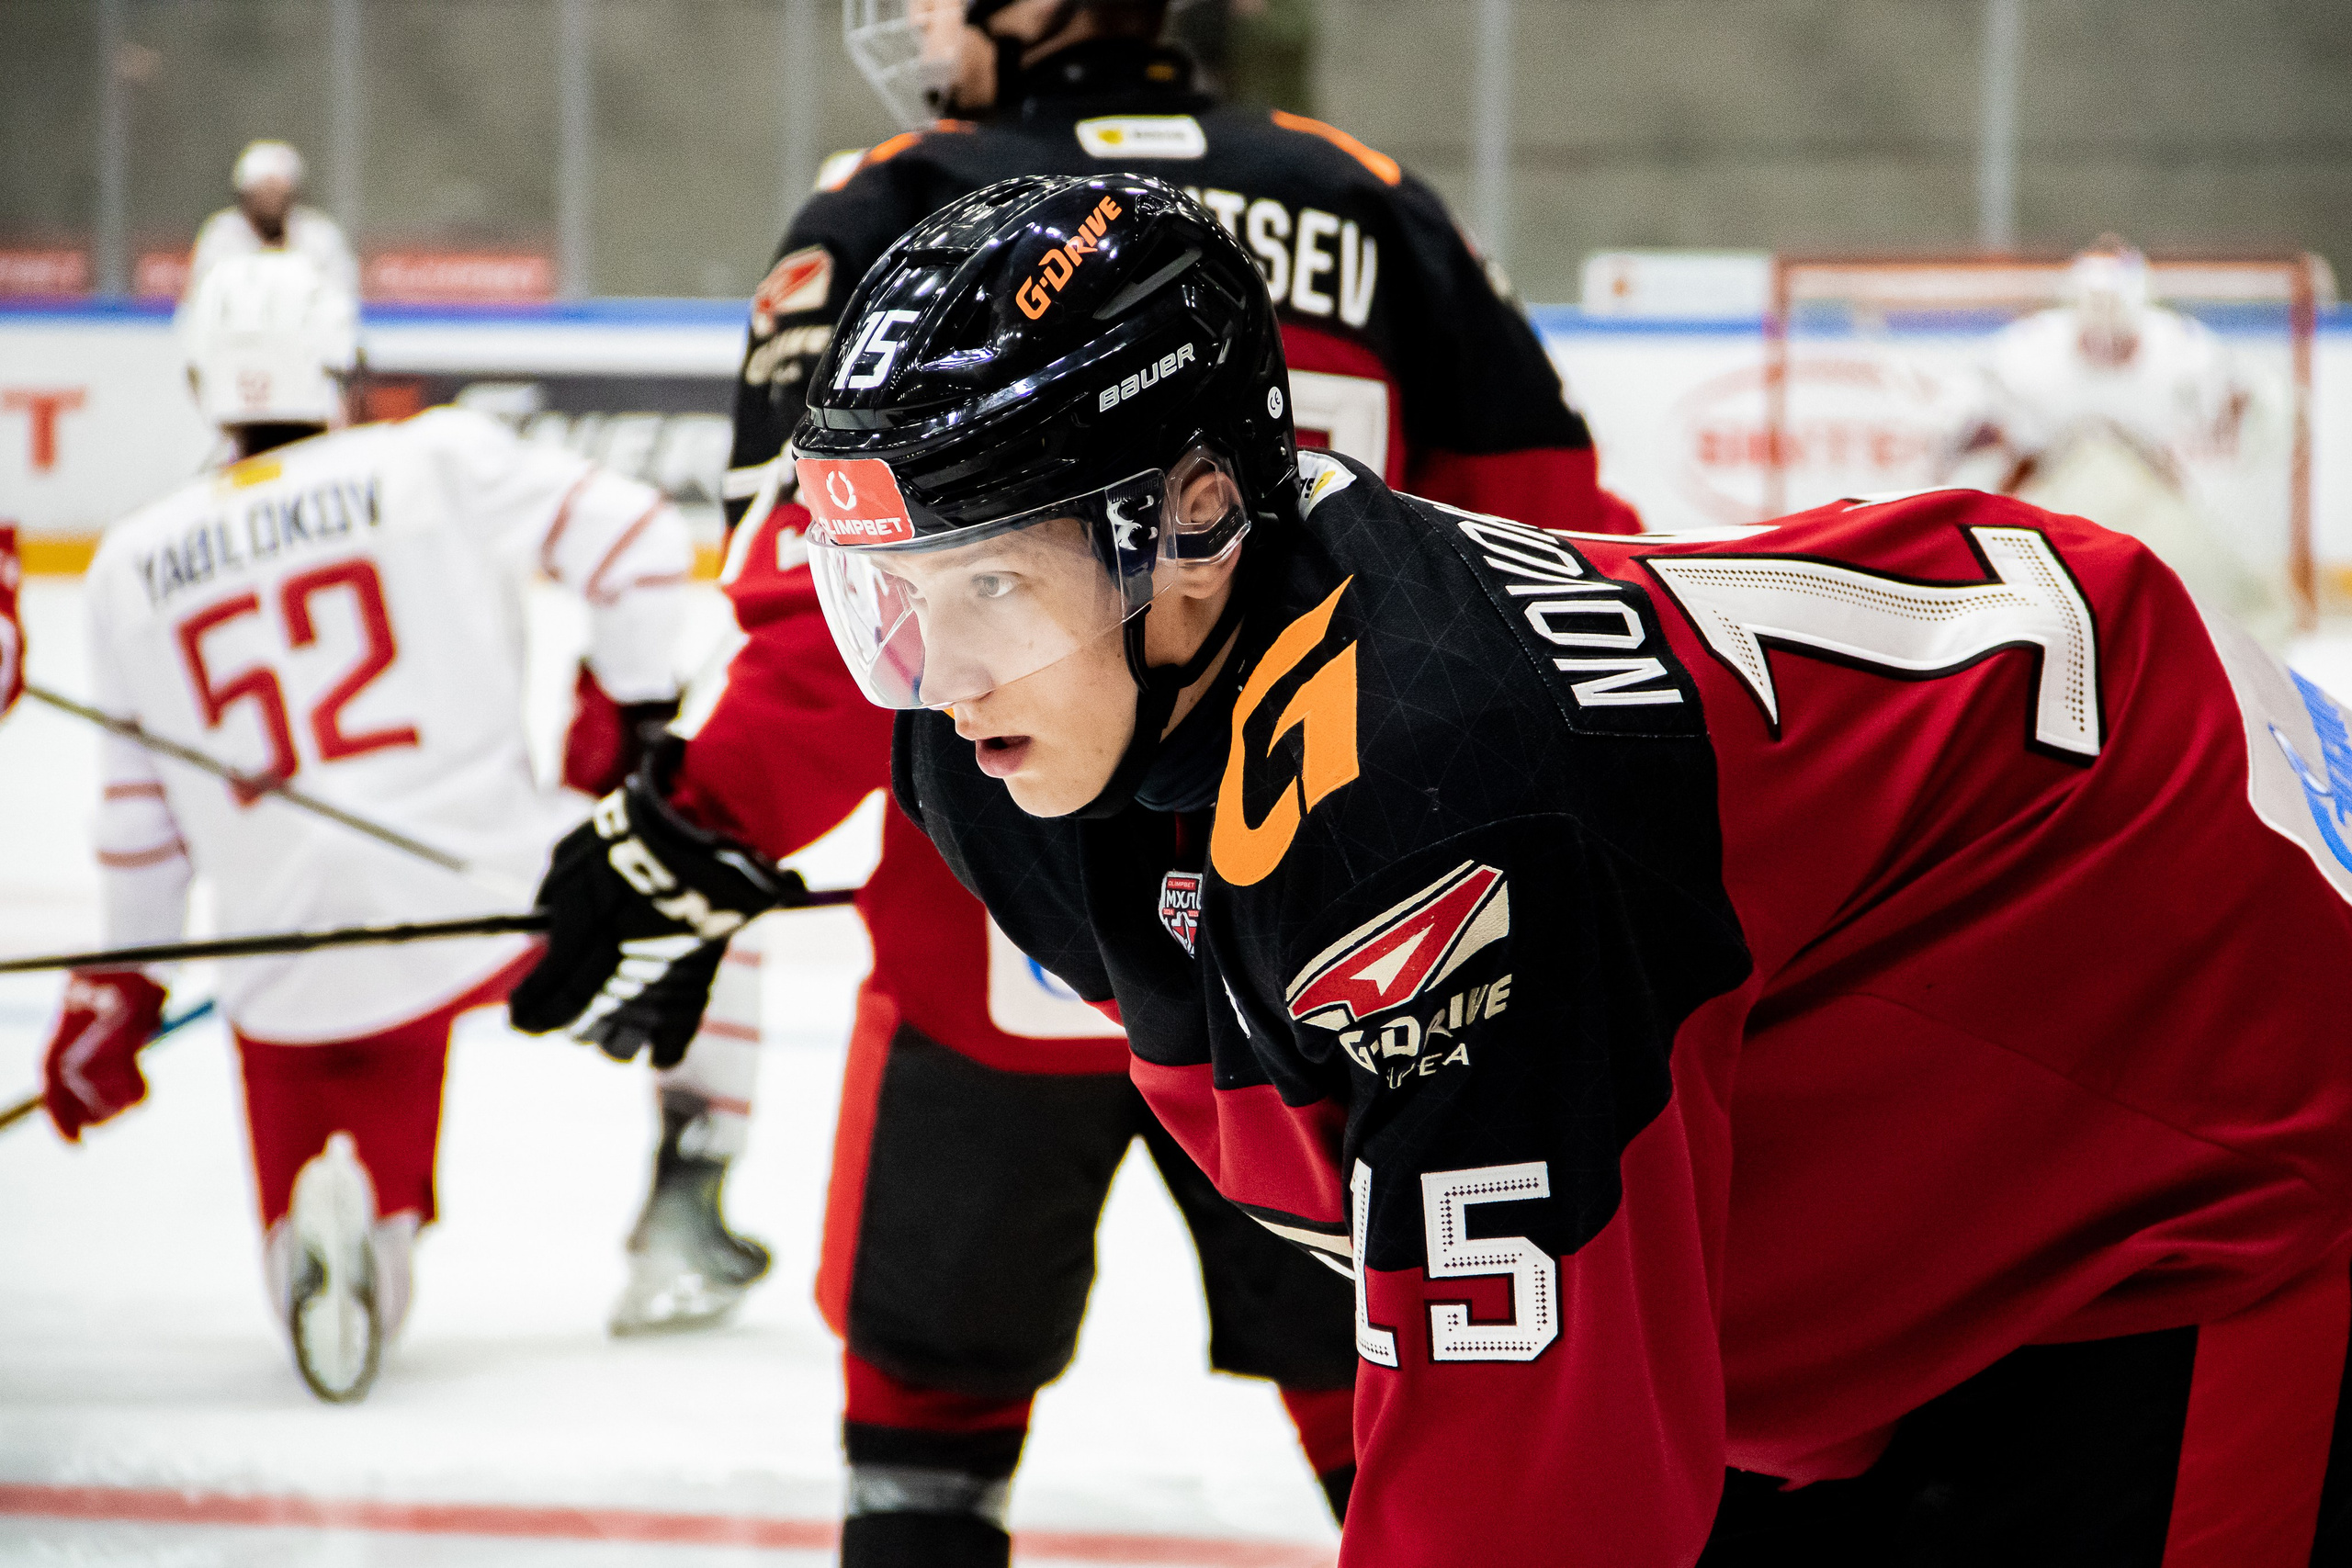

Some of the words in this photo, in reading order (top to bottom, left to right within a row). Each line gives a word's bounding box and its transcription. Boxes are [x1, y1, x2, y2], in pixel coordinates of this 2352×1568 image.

[832, 309, 921, 390] 15
[134, 479, 381, 612] YABLOKOV
[1433, 504, 1684, 706] NOVO
[1643, 522, 2101, 758] 1
[177, 557, 419, 808] 52
[1350, 1158, 1559, 1368] 15
